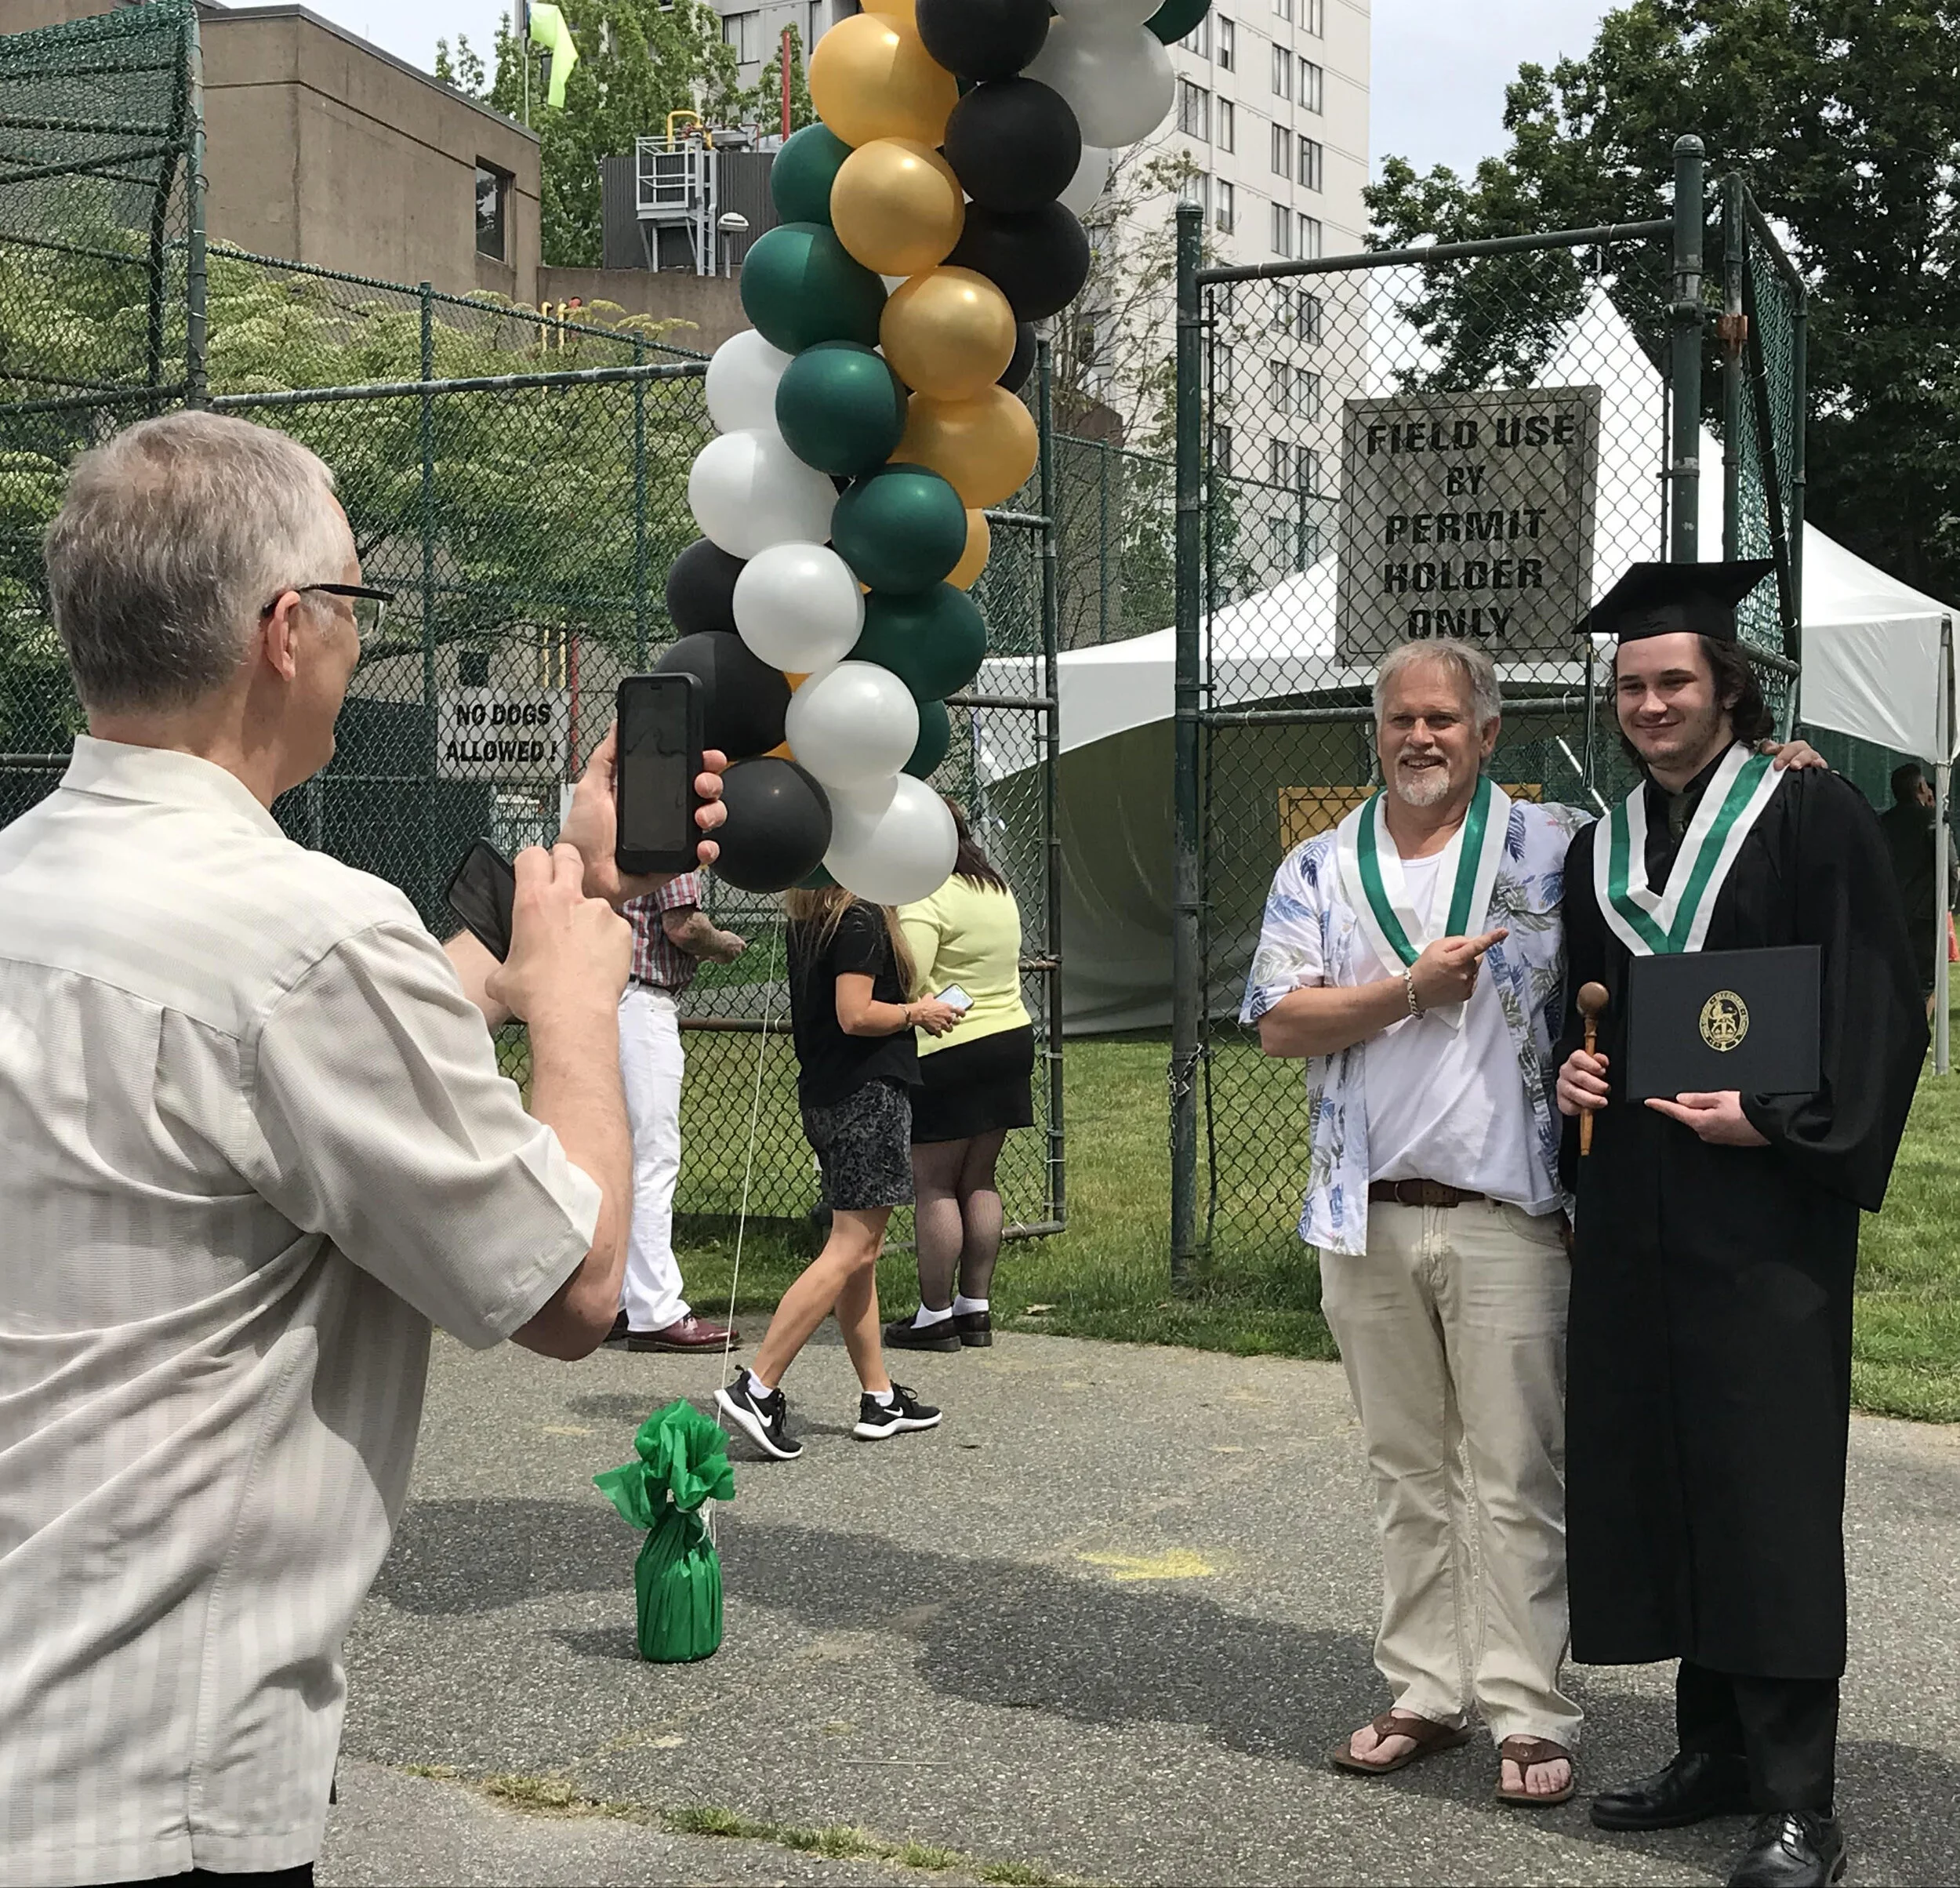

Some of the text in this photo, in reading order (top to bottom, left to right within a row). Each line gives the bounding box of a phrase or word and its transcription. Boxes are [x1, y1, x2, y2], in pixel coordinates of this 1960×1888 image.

[1367, 414, 1575, 455] FIELD USE
[1446, 465, 1486, 496] BY
[1385, 509, 1547, 545] PERMIT
[1383, 558, 1543, 593] HOLDER
[1407, 607, 1514, 639] ONLY
[456, 704, 551, 725] NO DOGS
[446, 740, 544, 762] ALLOWED
